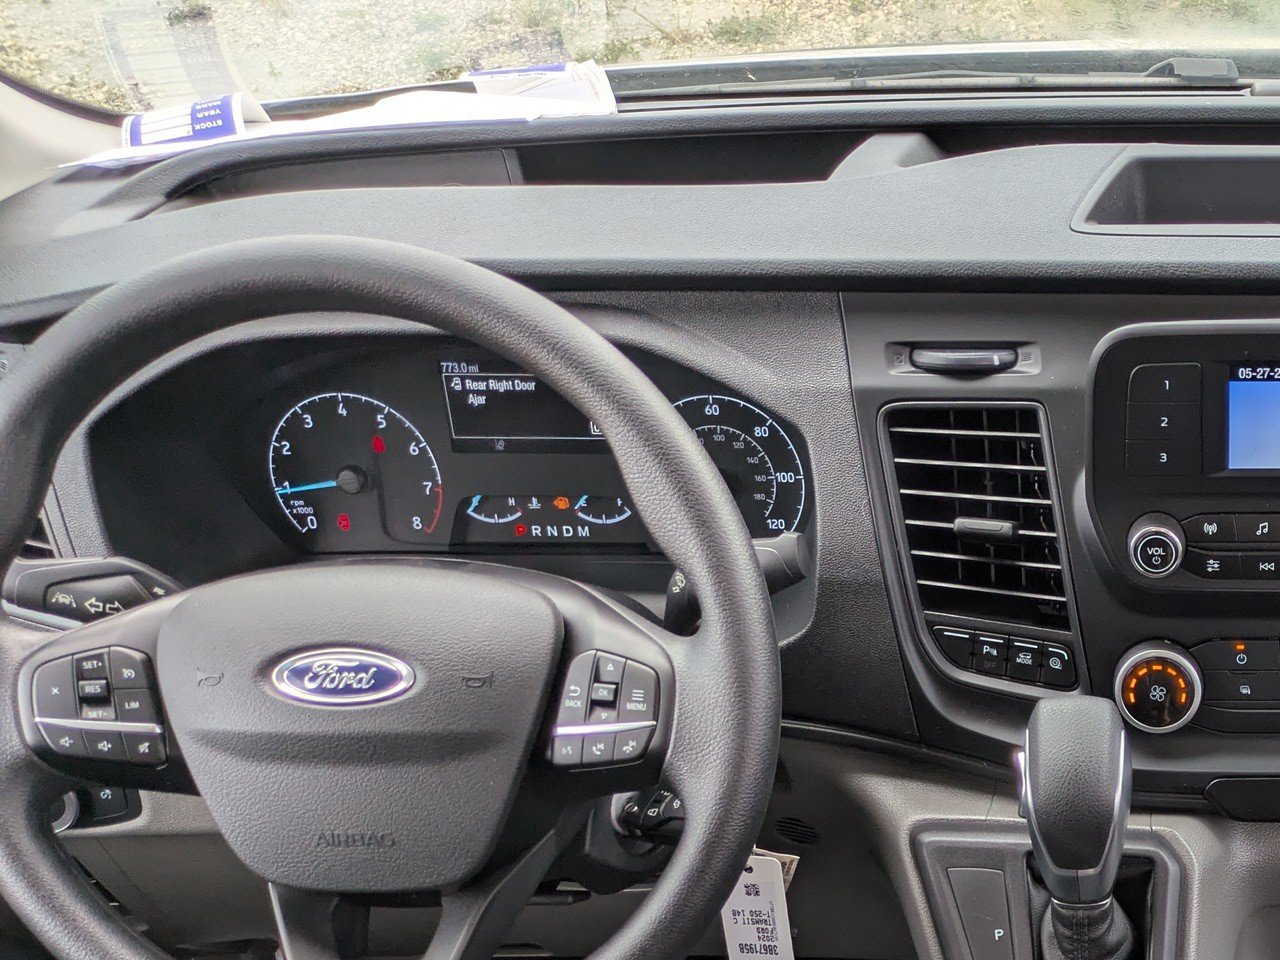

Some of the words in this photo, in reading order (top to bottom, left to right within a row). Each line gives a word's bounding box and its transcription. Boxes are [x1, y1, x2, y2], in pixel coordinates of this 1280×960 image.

[194, 120, 223, 130] STOCK
[440, 362, 468, 373] 773.0
[468, 363, 479, 373] mi
[466, 380, 487, 390] Rear
[489, 379, 513, 392] Right
[515, 380, 536, 390] Door
[1164, 381, 1169, 390] 1
[468, 394, 487, 406] Ajar
[338, 403, 347, 417] 4
[705, 405, 720, 415] 60
[302, 415, 313, 428] 3
[376, 415, 387, 428] 5
[1160, 417, 1168, 427] 2
[754, 426, 769, 437] 80
[280, 442, 292, 455] 2
[409, 442, 419, 455] 6
[732, 441, 744, 449] 120
[746, 456, 759, 464] 140
[1159, 453, 1168, 462] 3
[775, 472, 795, 483] 100
[423, 482, 432, 495] 7
[307, 516, 317, 529] 0
[412, 517, 422, 529] 8
[766, 519, 785, 530] 120
[516, 525, 527, 537] P
[532, 526, 542, 536] R
[547, 526, 558, 537] N
[562, 526, 573, 537] D
[578, 526, 590, 537] M
[1147, 547, 1165, 555] VOL
[1015, 657, 1033, 665] MODE
[304, 660, 378, 690] Ford
[125, 701, 139, 709] LIM
[565, 700, 581, 708] BACK
[626, 702, 647, 711] MENU
[316, 832, 396, 848] AIRBAG
[749, 910, 771, 918] T-250
[756, 927, 774, 935] FORD
[994, 929, 1004, 940] P
[757, 934, 775, 942] 2024
